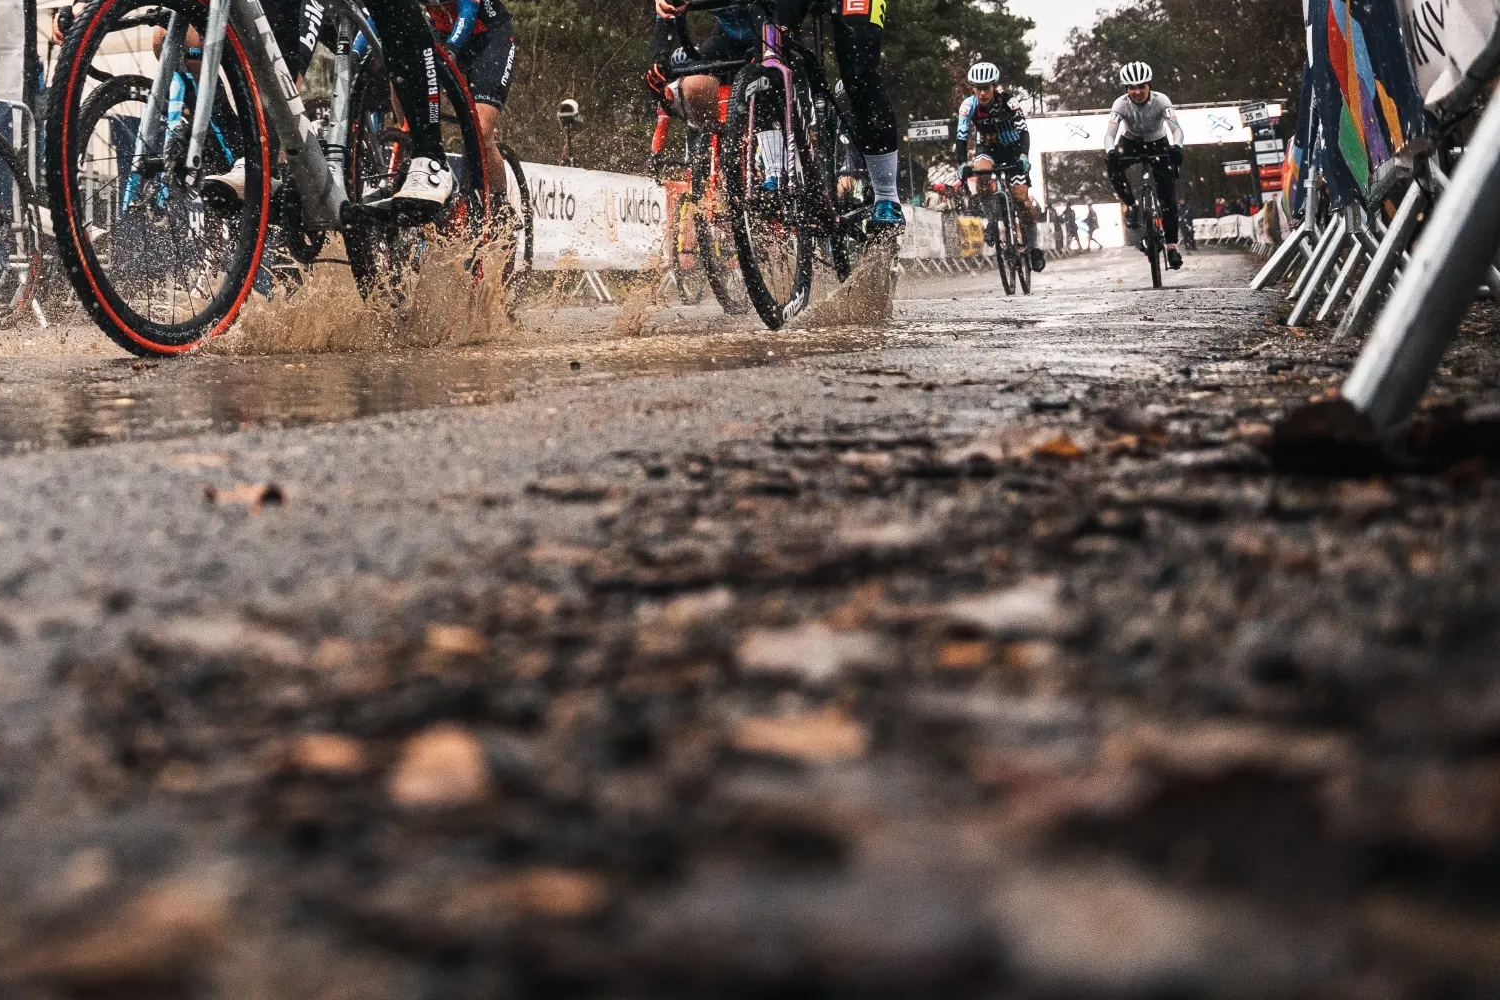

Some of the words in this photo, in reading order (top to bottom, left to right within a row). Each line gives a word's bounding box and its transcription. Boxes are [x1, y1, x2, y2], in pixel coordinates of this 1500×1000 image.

[422, 47, 439, 96] RACING
[500, 44, 516, 87] minimax
[916, 128, 928, 136] 25
[1244, 112, 1254, 121] 25
[530, 178, 576, 221] klid.to
[619, 186, 661, 226] uklid.to
